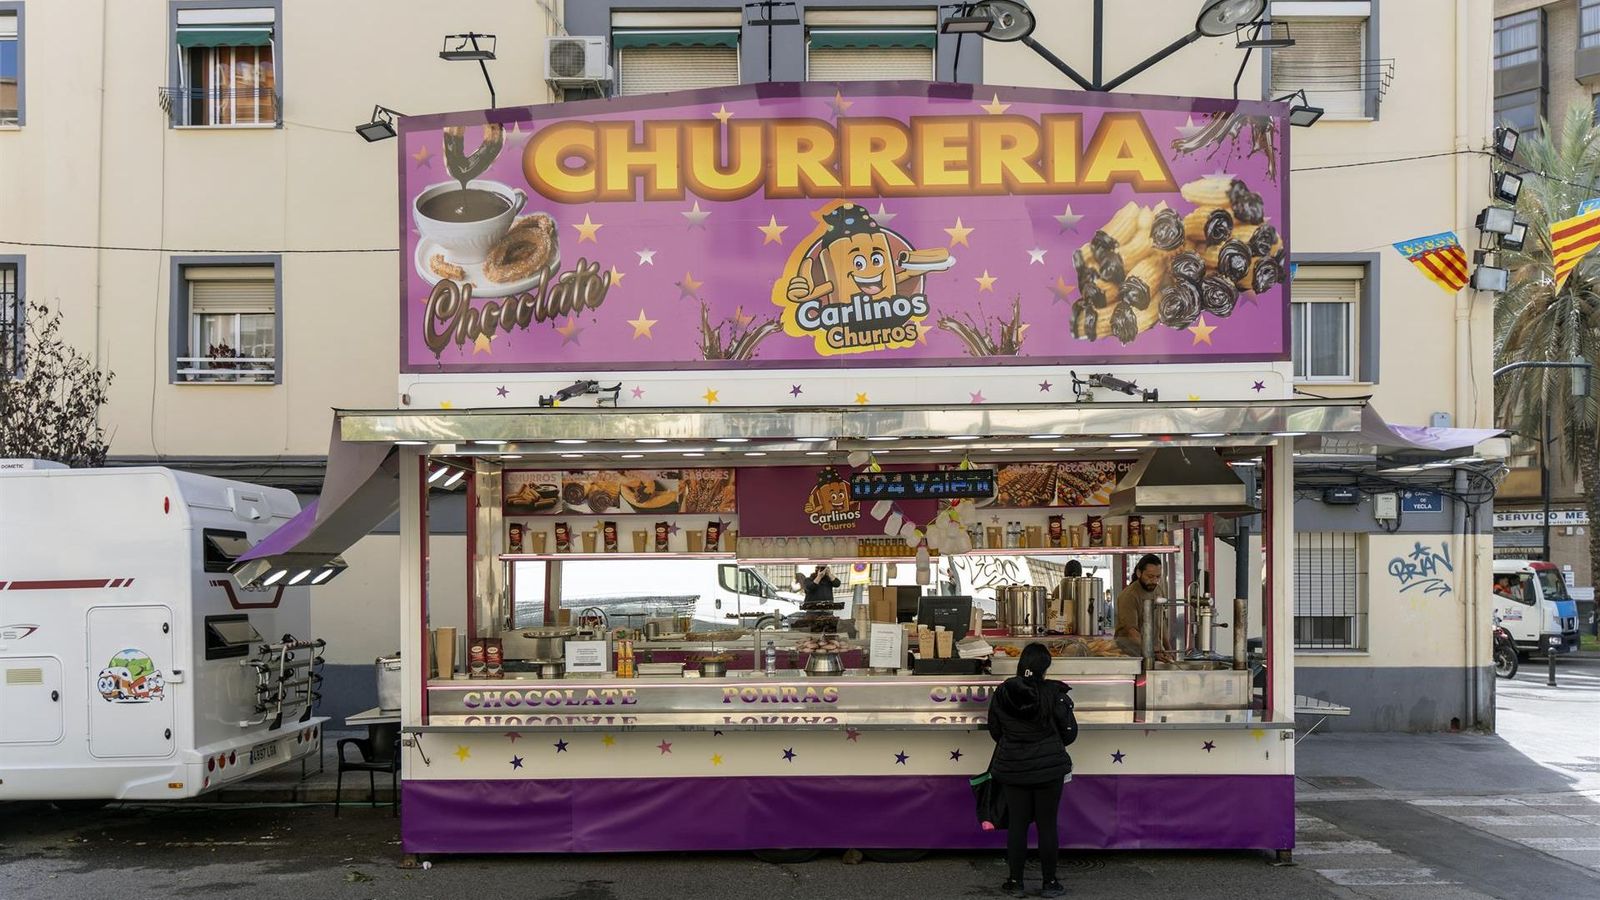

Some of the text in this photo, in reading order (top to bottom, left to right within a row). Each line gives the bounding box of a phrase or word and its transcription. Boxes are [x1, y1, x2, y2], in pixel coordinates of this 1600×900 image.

[523, 112, 1178, 202] CHURRERIA
[423, 256, 611, 352] Chocolate
[797, 294, 927, 327] Carlinos
[826, 323, 917, 348] Churros
[1059, 462, 1115, 472] DECORADOS
[809, 509, 861, 524] Carlinos
[822, 522, 856, 531] Churros
[1497, 512, 1557, 521] SERVICO
[463, 685, 998, 709] CHOCOLATE PORRAS CHU
